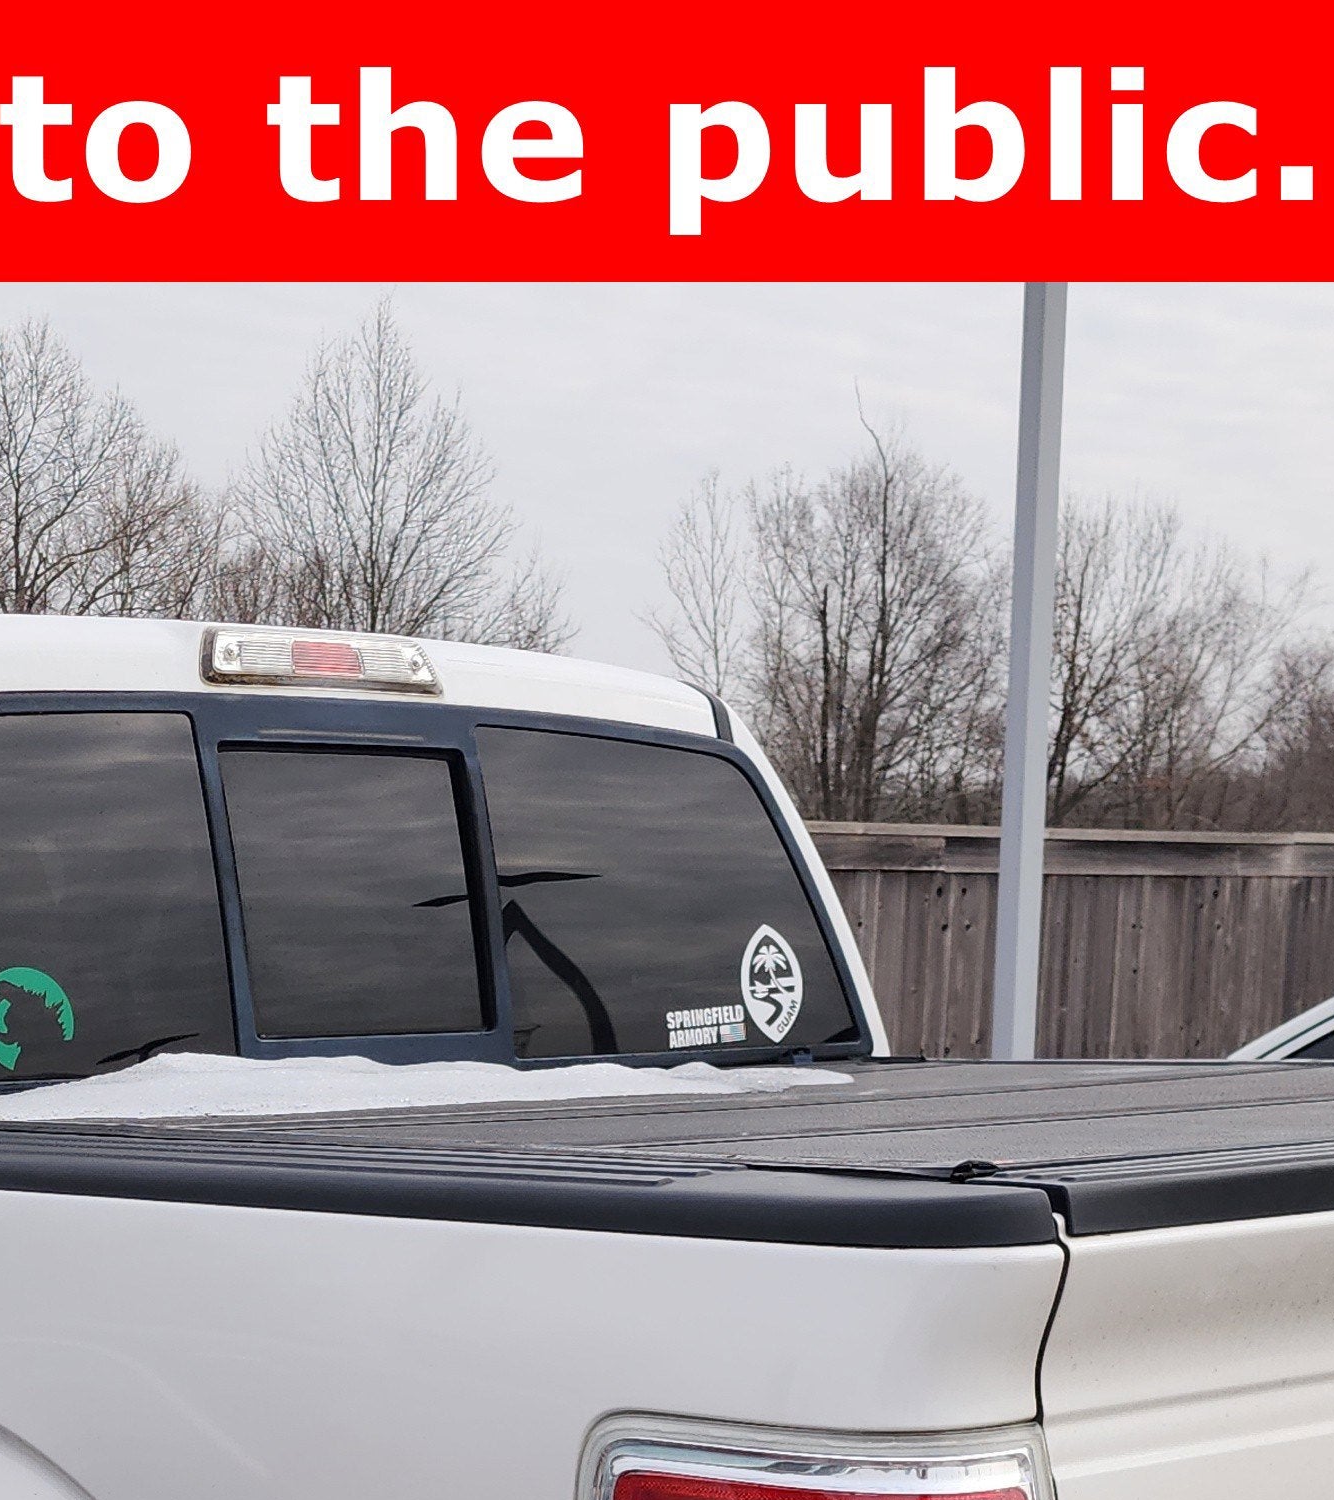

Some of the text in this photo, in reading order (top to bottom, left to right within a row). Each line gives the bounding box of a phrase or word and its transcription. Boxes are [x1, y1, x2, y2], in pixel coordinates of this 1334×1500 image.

[665, 1004, 745, 1030] SPRINGFIELD
[776, 1000, 799, 1034] GUAM
[669, 1025, 718, 1049] ARMORY
